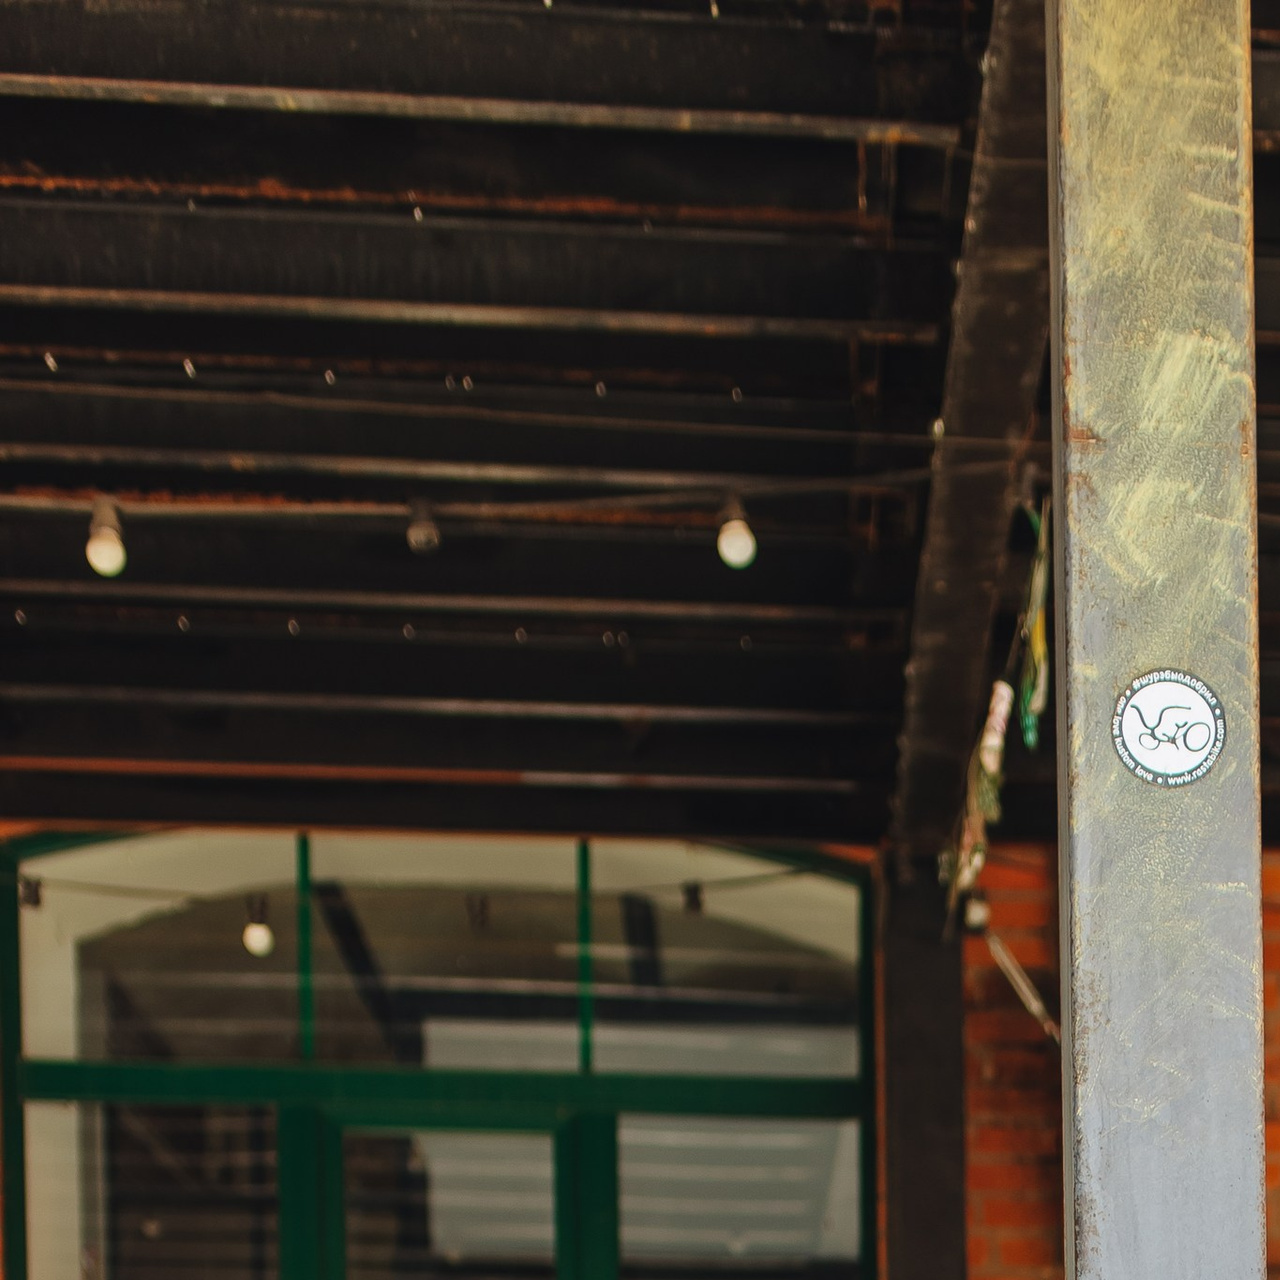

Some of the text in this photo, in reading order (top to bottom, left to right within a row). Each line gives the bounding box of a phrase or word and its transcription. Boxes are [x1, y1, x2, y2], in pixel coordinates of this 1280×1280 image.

[1114, 736, 1136, 768] kustom
[1135, 765, 1154, 781] love
[1167, 719, 1225, 785] www.rastabike.com
